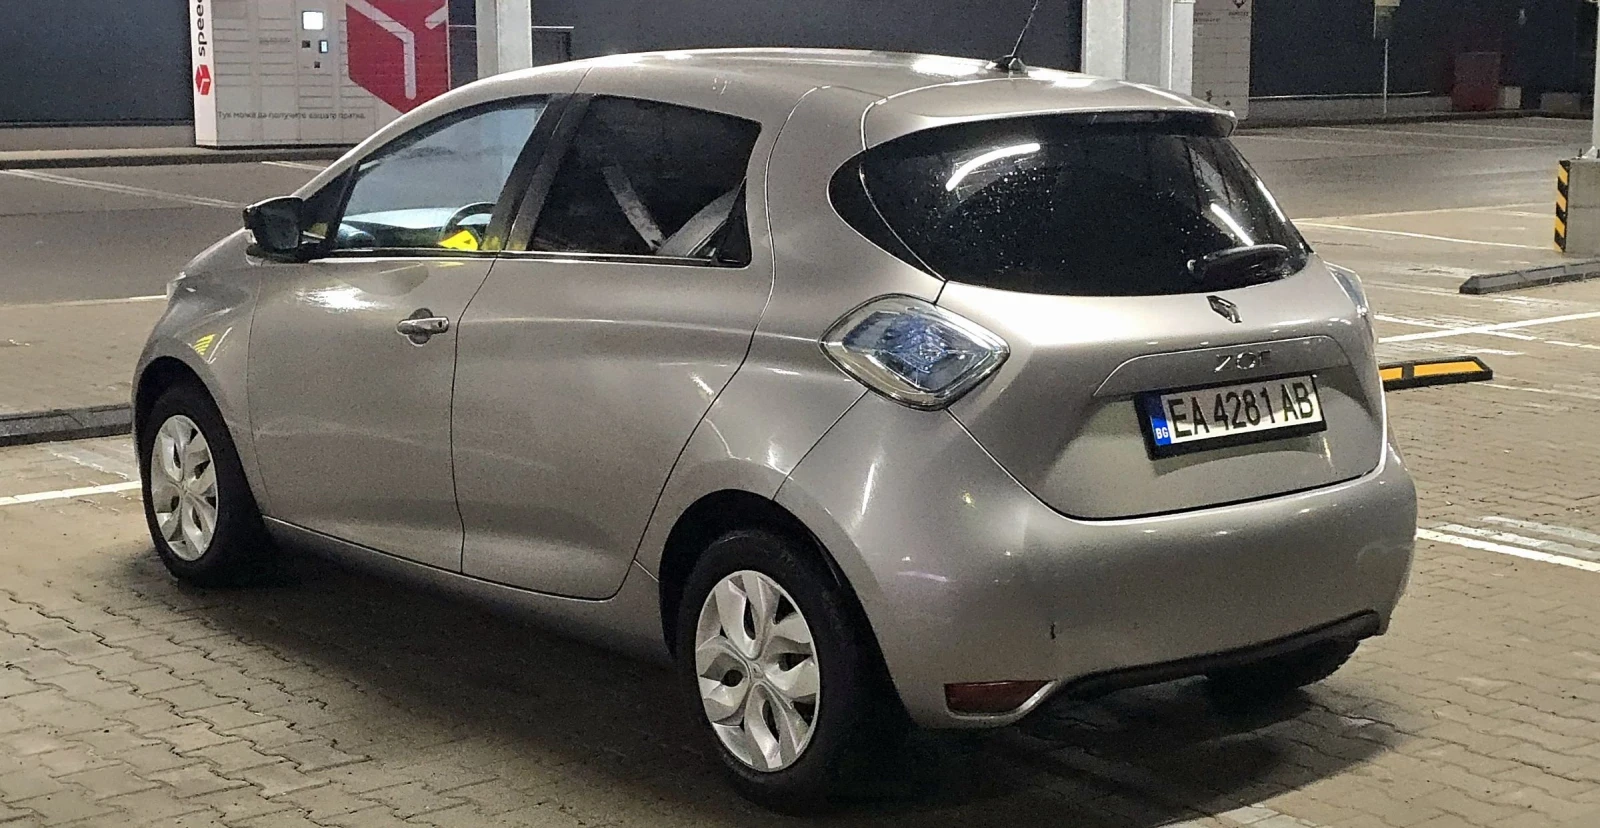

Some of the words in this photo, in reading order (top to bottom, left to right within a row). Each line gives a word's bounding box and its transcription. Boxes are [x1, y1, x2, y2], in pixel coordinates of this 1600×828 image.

[197, 0, 208, 57] spee
[1155, 426, 1169, 440] BG
[1168, 397, 1210, 439] EA
[1214, 386, 1276, 431] 4281
[1281, 382, 1313, 422] AB
